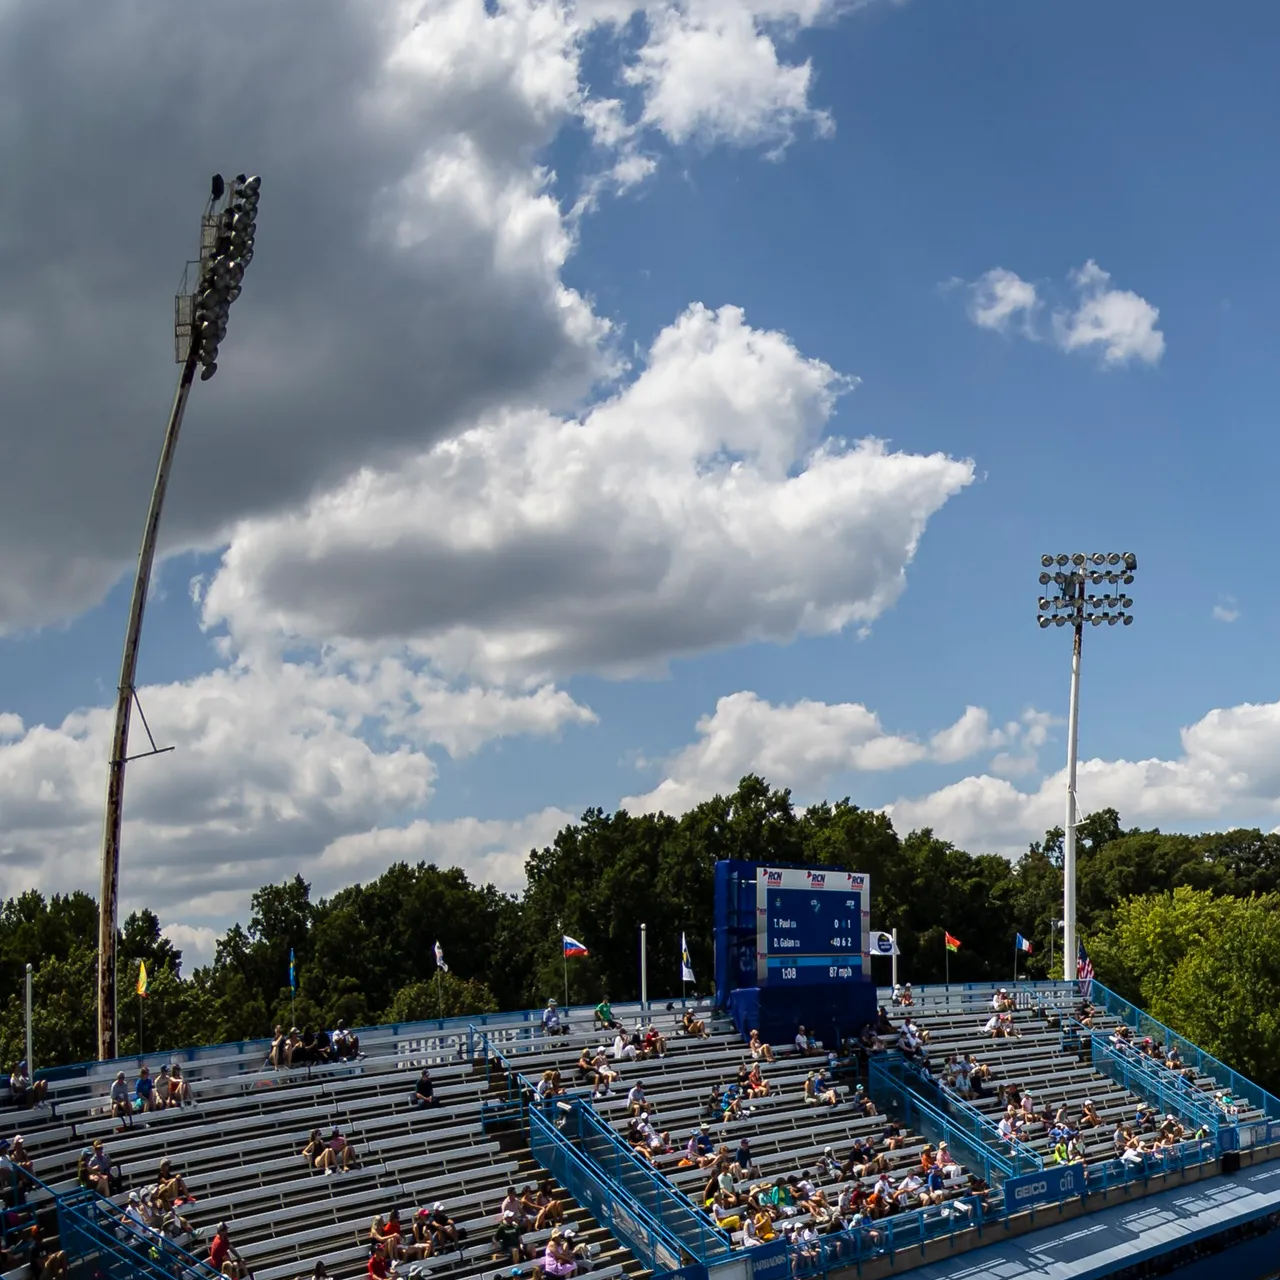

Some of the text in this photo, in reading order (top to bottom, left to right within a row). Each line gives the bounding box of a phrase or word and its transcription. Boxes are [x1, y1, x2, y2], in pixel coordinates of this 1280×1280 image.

[768, 871, 782, 881] RCN
[811, 874, 826, 883] RCN
[851, 876, 864, 885] RCN
[779, 919, 790, 928] Paul
[782, 968, 796, 979] 1:08
[829, 966, 852, 979] 87 mph
[1060, 1172, 1074, 1191] citi
[1015, 1181, 1047, 1199] GEICO
